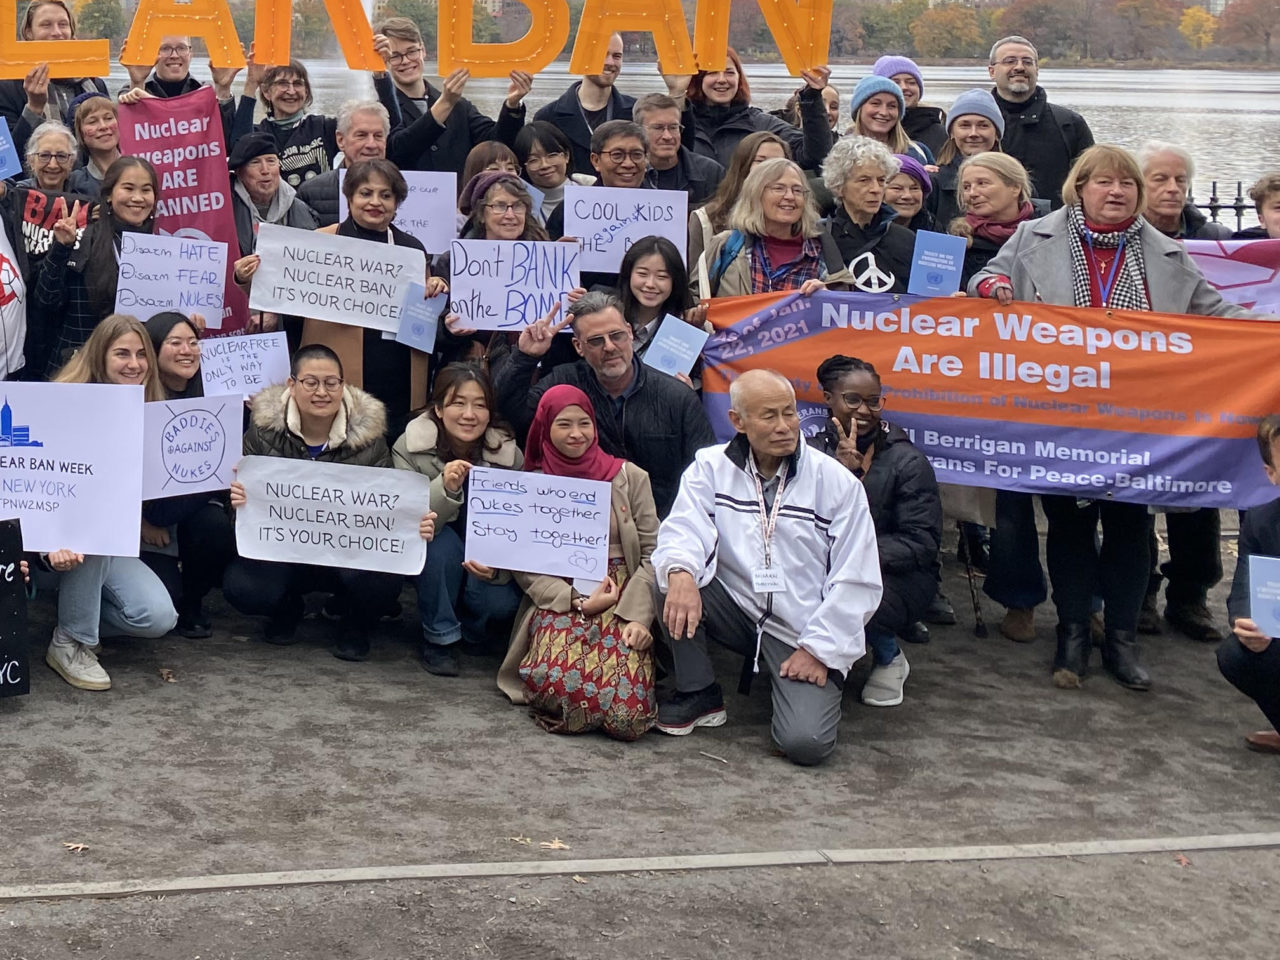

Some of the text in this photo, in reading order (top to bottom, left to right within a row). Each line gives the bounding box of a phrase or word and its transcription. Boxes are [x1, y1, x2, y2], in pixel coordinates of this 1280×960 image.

[134, 115, 211, 141] Nuclear
[132, 141, 220, 167] weapons
[161, 168, 198, 191] ARE
[155, 192, 225, 218] ANNED
[574, 199, 626, 222] COOL
[283, 245, 403, 278] NUCLEAR WAR?
[451, 240, 504, 278] Don't
[504, 241, 578, 290] BANK
[283, 266, 397, 298] NUCLEAR BAN!
[272, 286, 297, 301] IT'S
[300, 289, 340, 311] YOUR
[342, 297, 404, 319] CHOICE!
[719, 339, 754, 360] 22,
[758, 320, 810, 348] 2021
[821, 302, 1194, 355] Nuclear Weapons
[205, 361, 262, 382] ONLY WAY
[221, 374, 262, 390] TO BE
[892, 345, 1111, 393] Are Illegal
[798, 407, 829, 418] ERANS
[882, 385, 983, 404] Prohibition
[989, 395, 1006, 407] of
[1013, 396, 1090, 415] Nuclear
[1096, 402, 1187, 422] Weapons
[165, 415, 220, 443] BADDIES
[174, 441, 212, 454] AGAINST
[924, 431, 1026, 455] Berrigan
[1035, 440, 1150, 466] Memorial
[30, 458, 54, 471] BAN
[59, 462, 93, 475] WEEK
[172, 460, 211, 479] NUKES
[925, 456, 1232, 494] rans For Peace-Baltimore
[2, 479, 77, 498] NEW YORK
[266, 482, 400, 510] NUCLEAR WAR?
[470, 470, 596, 503] Friends who end
[269, 505, 395, 531] NUCLEAR BAN!
[529, 503, 601, 523] together
[259, 527, 405, 554] IT'S YOUR CHOICE!
[472, 521, 607, 548] Stay together!
